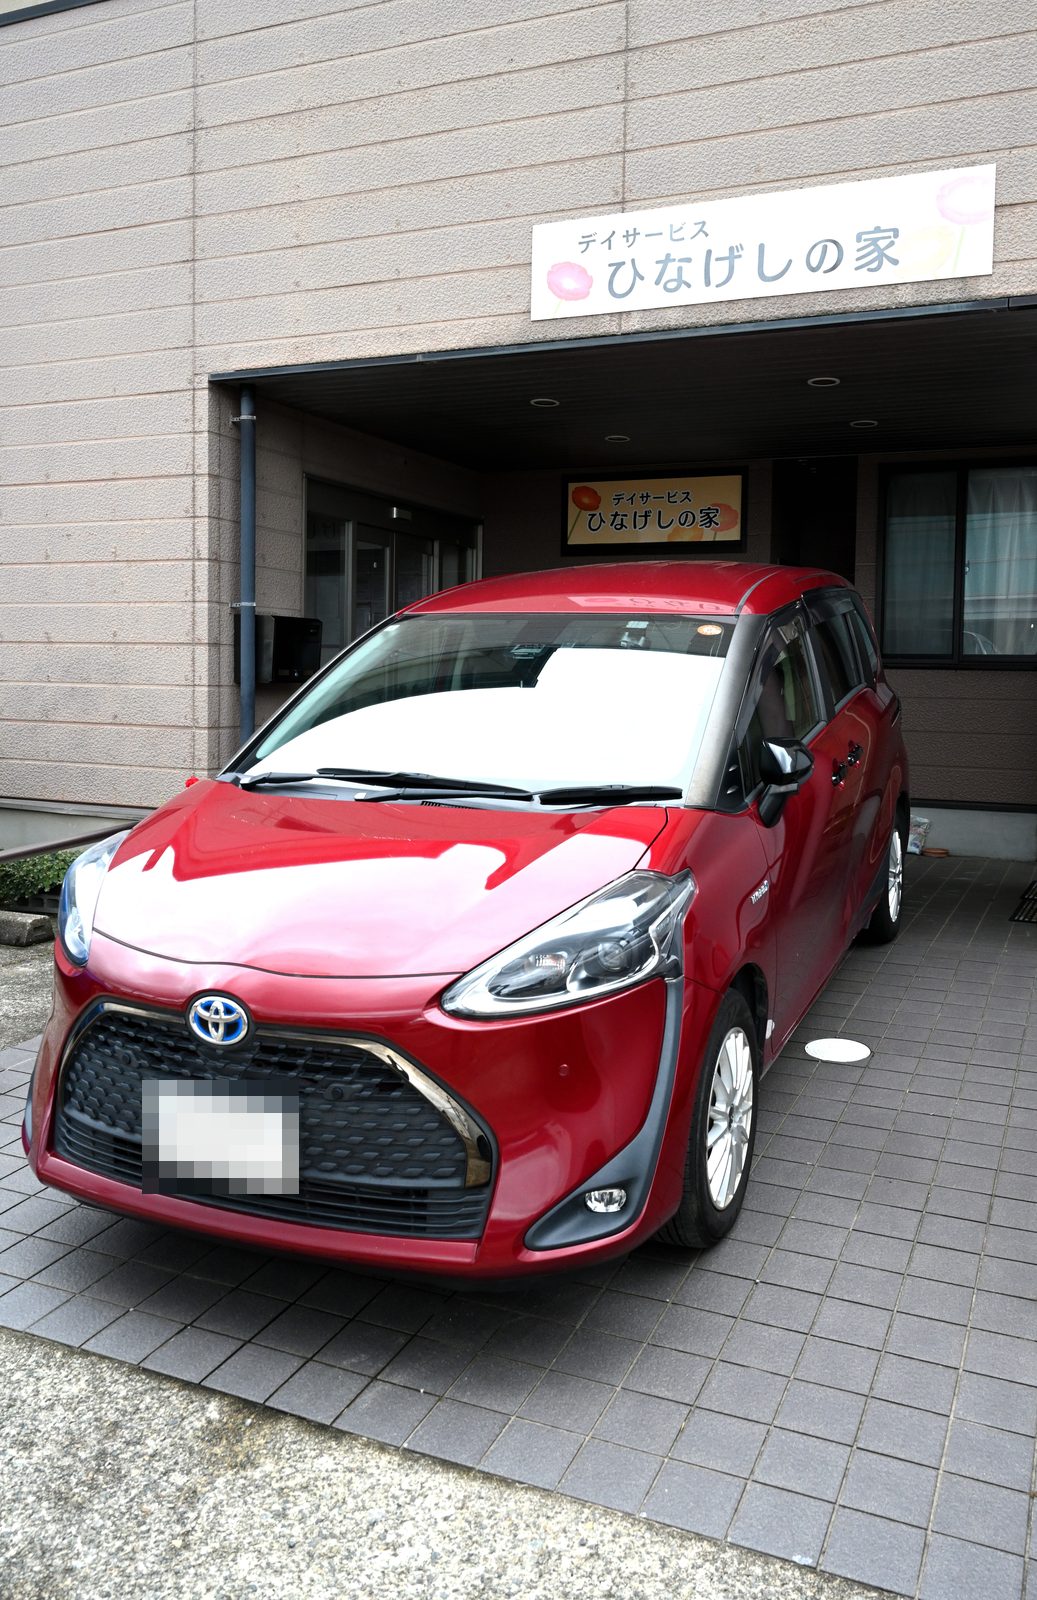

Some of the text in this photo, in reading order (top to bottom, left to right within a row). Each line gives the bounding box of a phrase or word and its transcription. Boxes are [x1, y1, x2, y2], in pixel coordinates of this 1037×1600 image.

[579, 220, 709, 254] デイサービス
[607, 225, 900, 299] ひなげしの家
[612, 491, 692, 506] デイサービス
[587, 506, 721, 532] ひなげしの家
